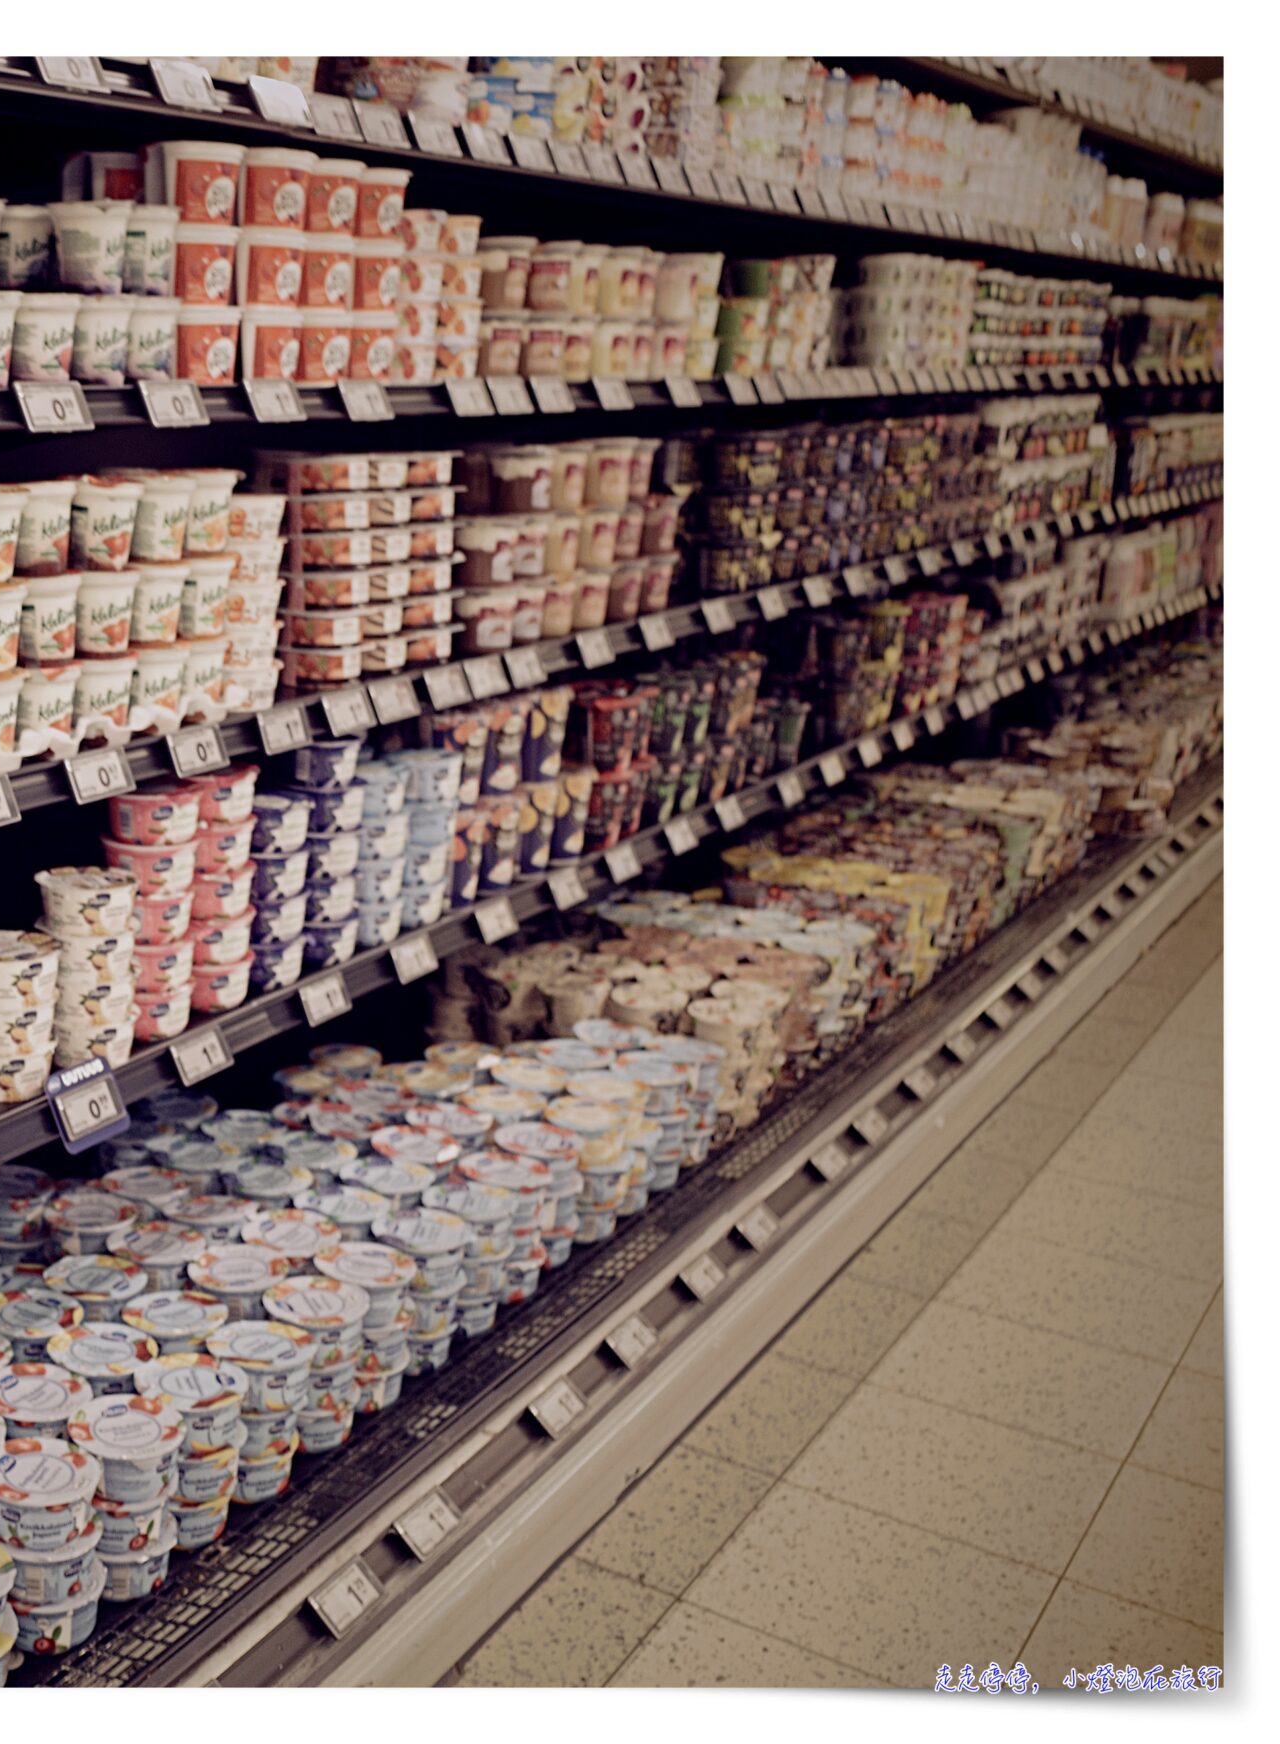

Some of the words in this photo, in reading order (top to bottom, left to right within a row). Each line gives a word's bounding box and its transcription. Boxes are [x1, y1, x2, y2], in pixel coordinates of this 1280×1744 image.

[53, 400, 66, 420] 0
[197, 743, 208, 761] 0
[99, 767, 111, 786] 0
[89, 1100, 101, 1119] 0
